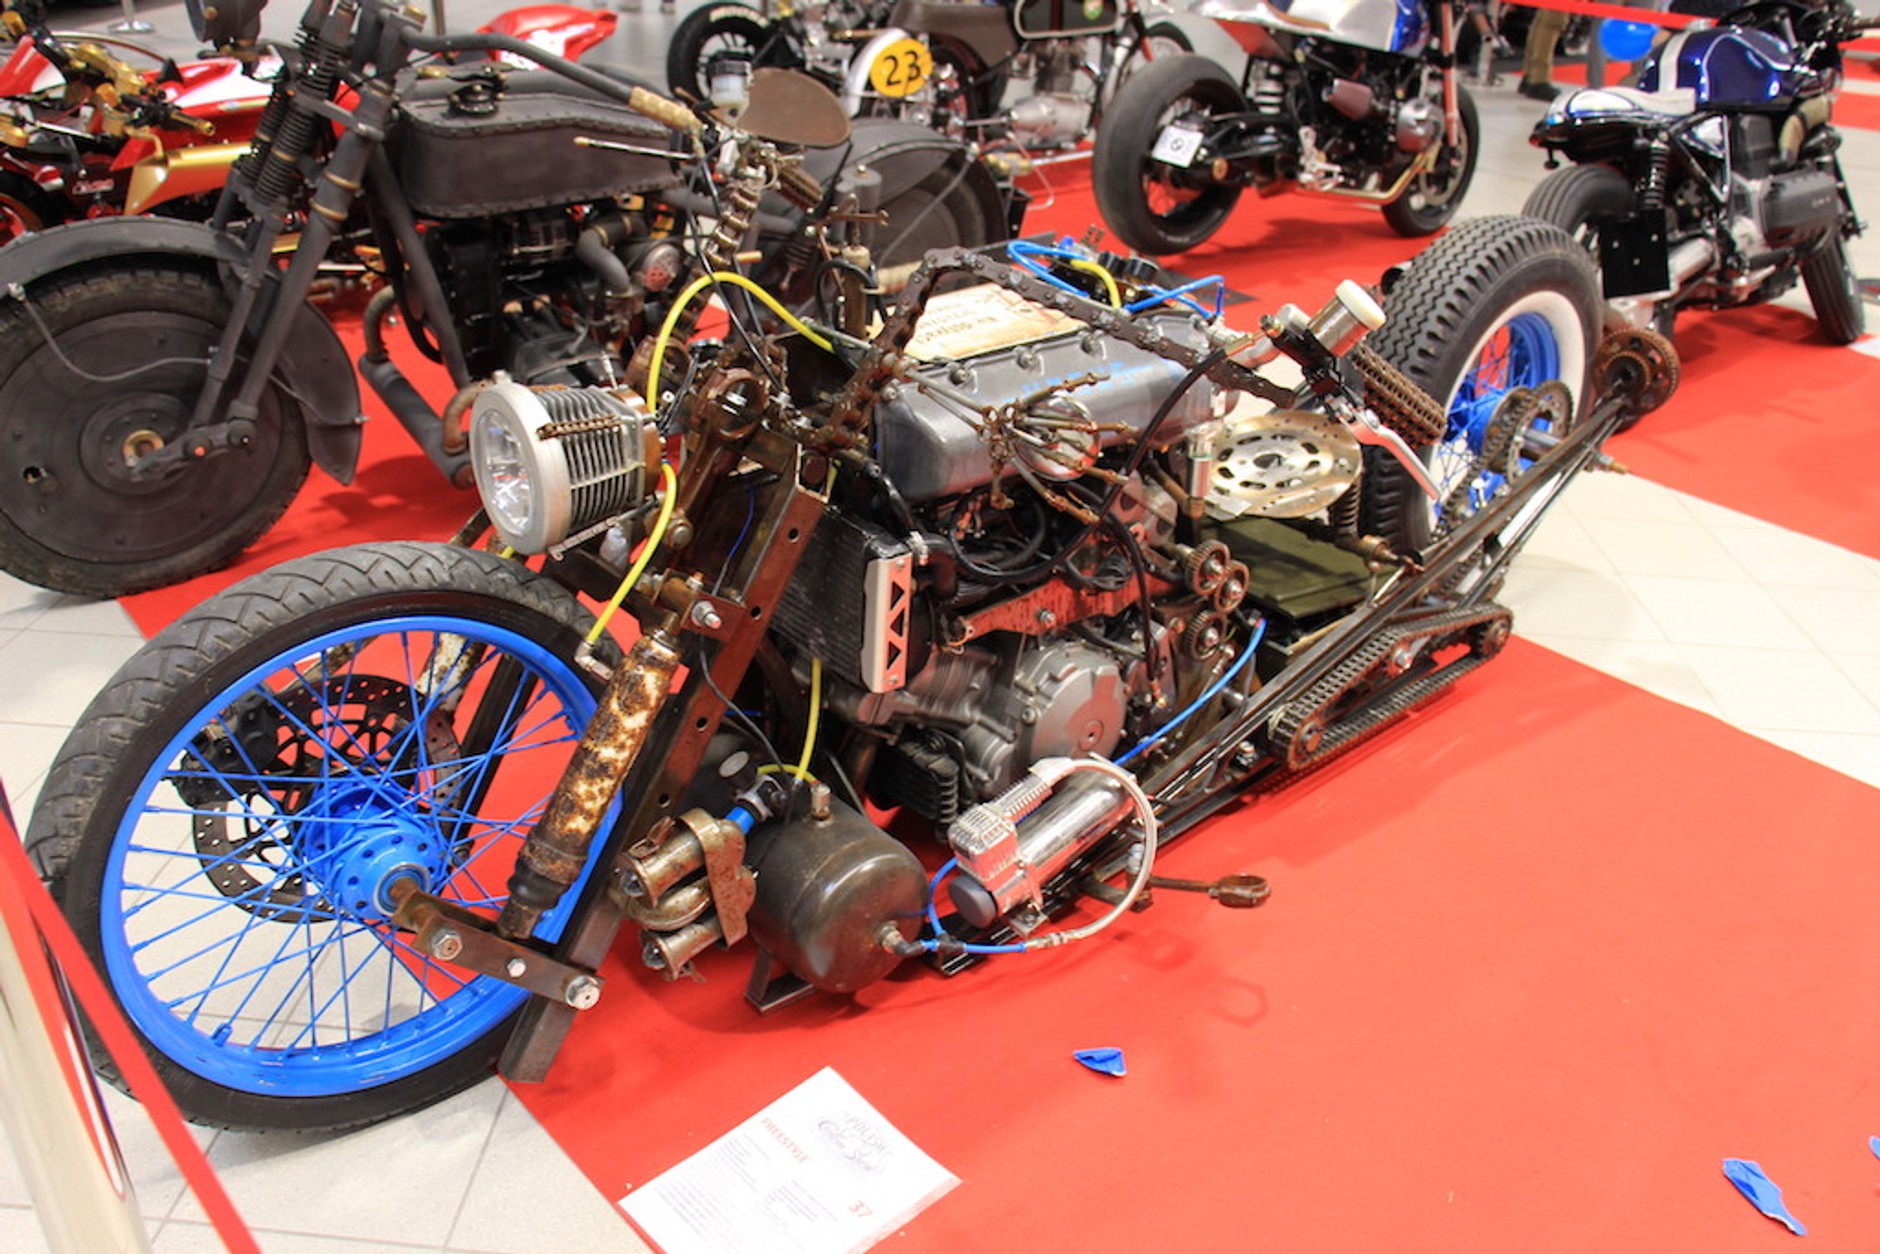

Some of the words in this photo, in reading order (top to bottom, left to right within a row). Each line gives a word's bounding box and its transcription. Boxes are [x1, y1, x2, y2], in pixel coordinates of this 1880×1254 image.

[883, 49, 921, 86] 23
[760, 1117, 810, 1164] FREESTYLE
[847, 1199, 874, 1218] 37
